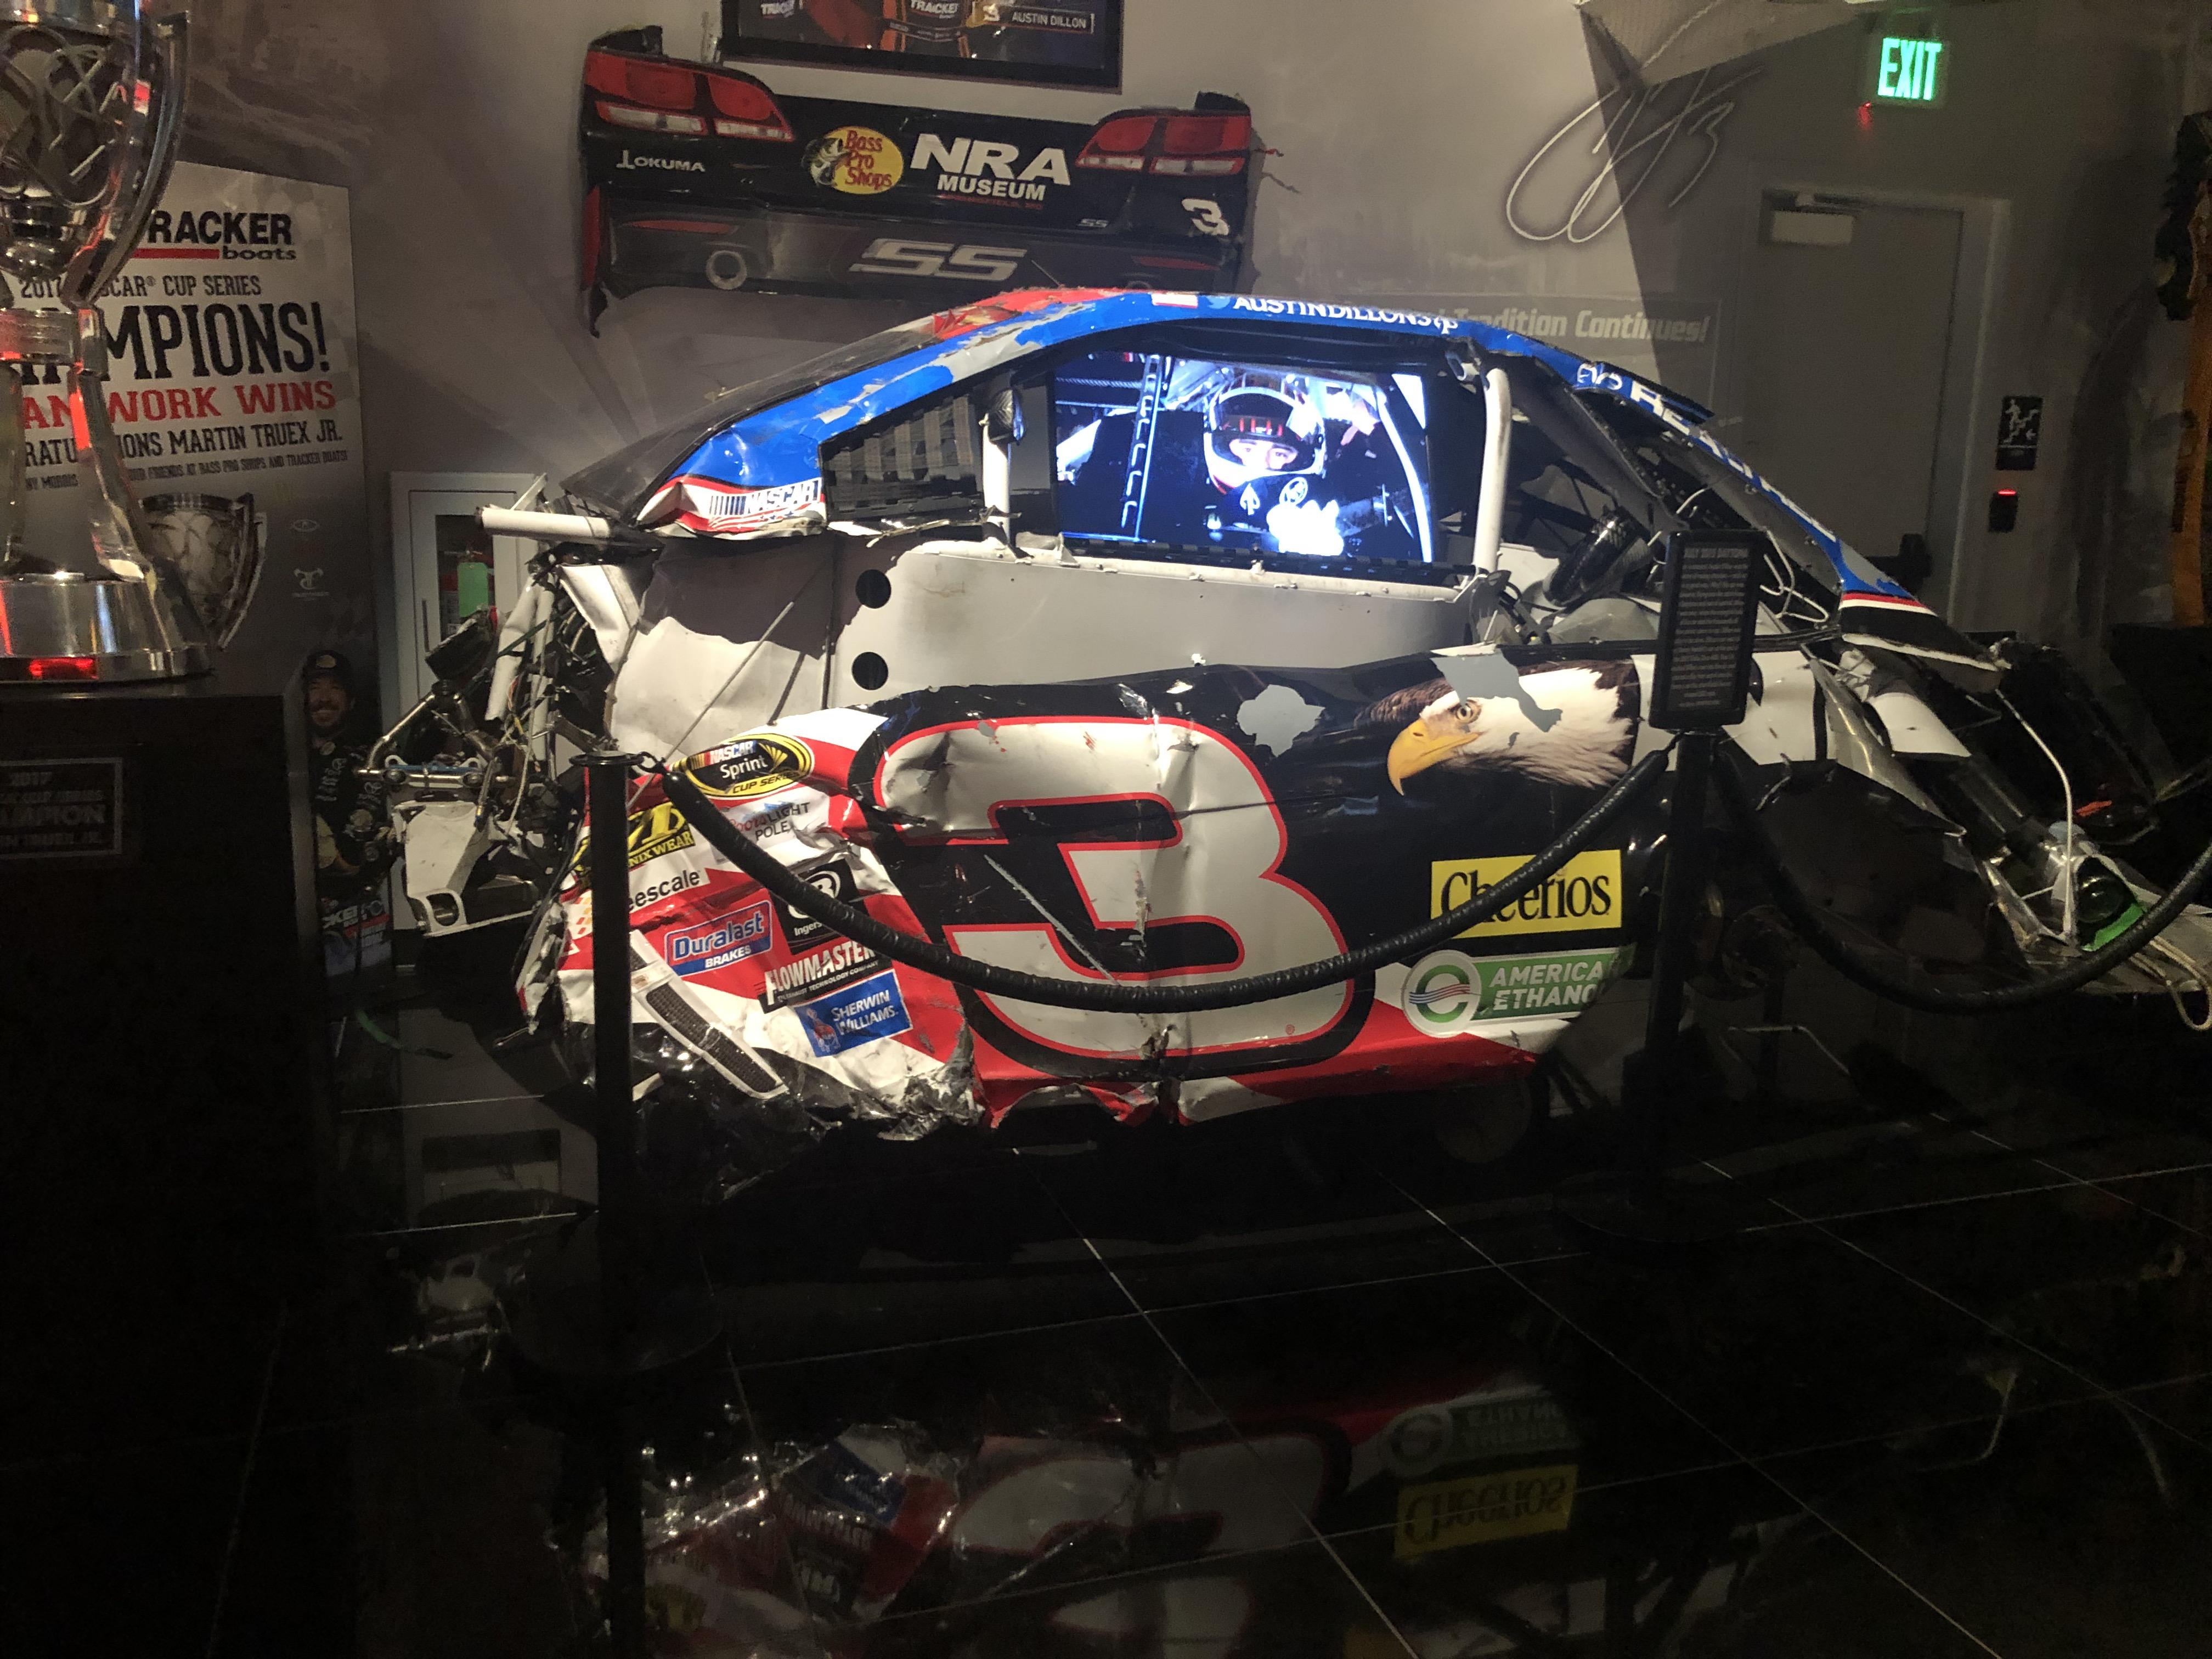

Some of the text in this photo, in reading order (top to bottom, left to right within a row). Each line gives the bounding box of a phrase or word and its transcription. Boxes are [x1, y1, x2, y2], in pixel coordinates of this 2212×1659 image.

[1012, 12, 1087, 29] AUSTIN DILLON
[1878, 37, 1942, 100] EXIT
[844, 130, 882, 153] Bass
[845, 150, 874, 169] Pro
[910, 133, 1070, 185] NRA
[845, 167, 891, 190] Shops
[937, 174, 1046, 201] MUSEUM
[148, 211, 291, 245] RACKER
[1182, 199, 1229, 235] 3
[222, 246, 297, 260] boats
[848, 238, 1027, 281] SS
[162, 275, 196, 296] CUP
[203, 275, 261, 296] SERIES
[1576, 310, 1711, 343] Continues!
[22, 301, 330, 385] MPIONS!
[234, 381, 335, 414] WINS
[168, 424, 249, 455] MARTIN
[251, 422, 311, 448] TRUEX
[315, 419, 342, 443] JR.
[720, 755, 768, 780] Sprint
[733, 781, 757, 794] CUP
[768, 802, 810, 822] LIGHT
[654, 831, 695, 855] WEAR
[755, 821, 791, 841] POLE
[873, 715, 1355, 1059] 3
[673, 911, 764, 960] Duralast
[794, 922, 822, 936] Ingers
[705, 945, 752, 968] BRAKES
[764, 940, 876, 1006] FLOWMASTER
[808, 972, 849, 991] TECHNOLOGY
[1489, 961, 1604, 988] AMERICA
[831, 989, 890, 1022] SHERWIN
